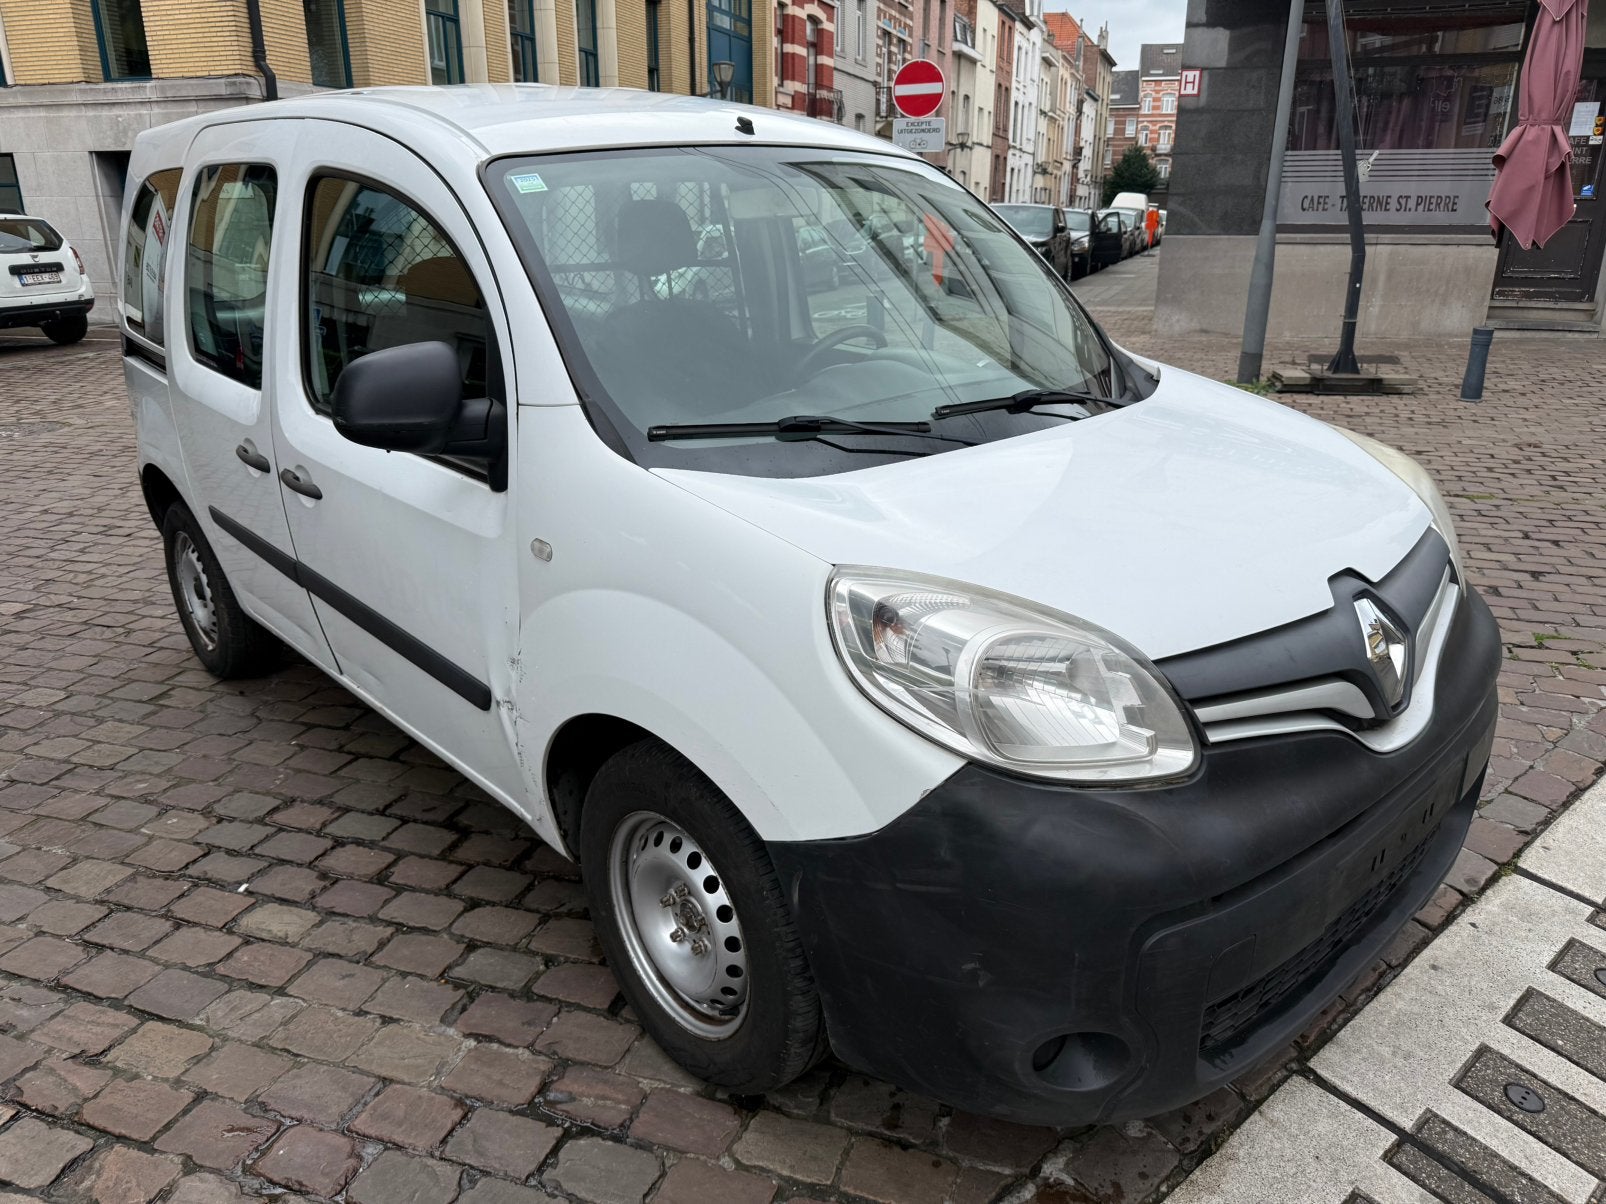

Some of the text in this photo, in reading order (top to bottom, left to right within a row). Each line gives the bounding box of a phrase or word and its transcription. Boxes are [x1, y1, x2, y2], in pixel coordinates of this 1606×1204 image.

[1184, 74, 1196, 91] H
[1569, 136, 1587, 145] AFE
[1300, 195, 1329, 212] CAFE
[1339, 195, 1391, 212] TERNE
[1395, 195, 1412, 212] ST.
[1414, 195, 1459, 213] PIERRE
